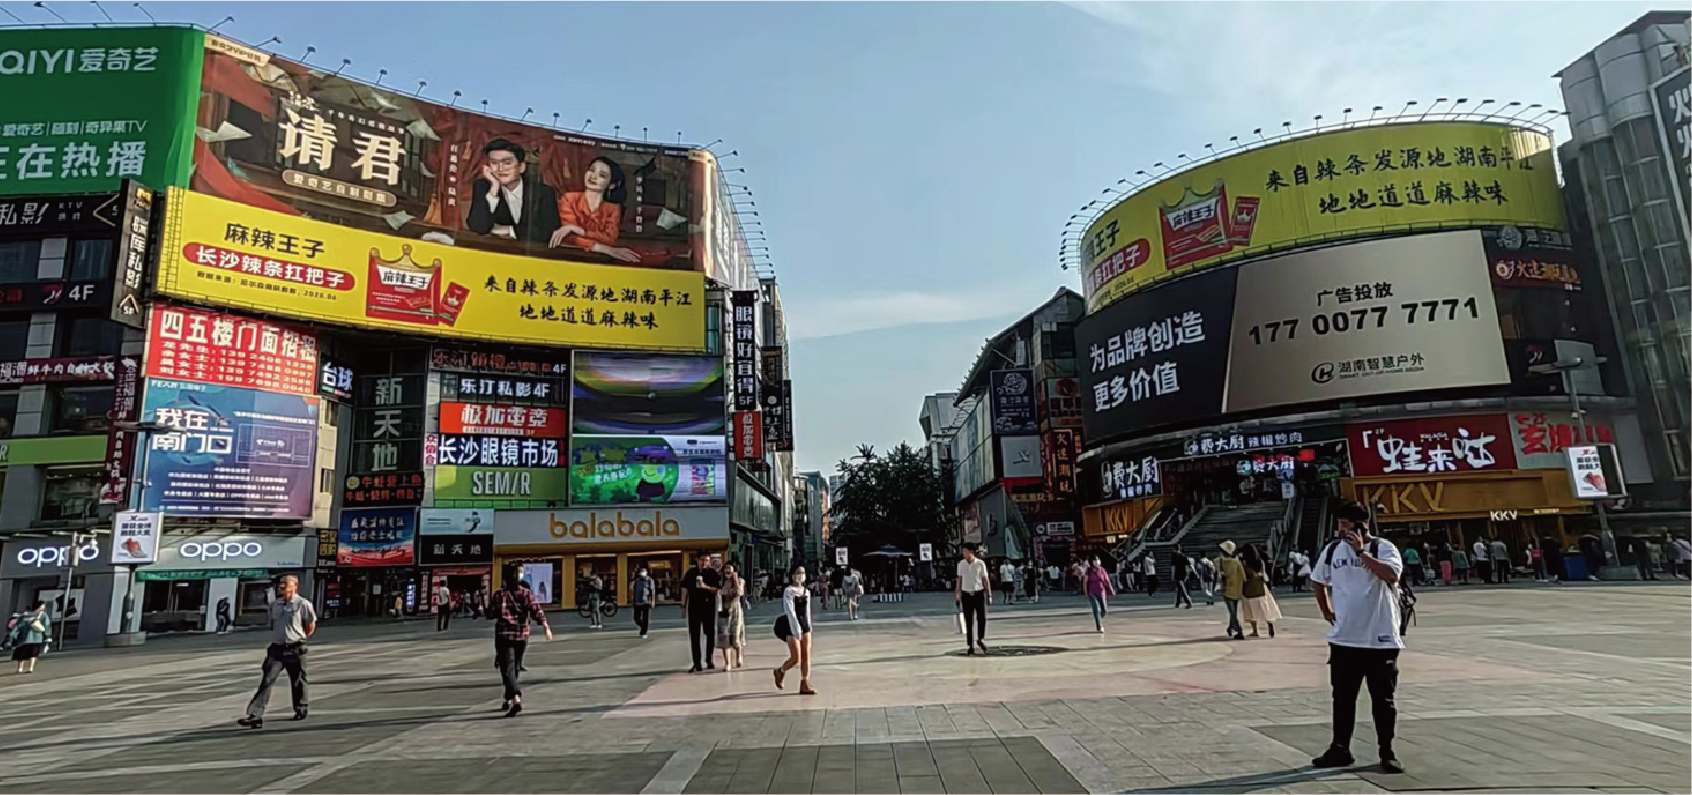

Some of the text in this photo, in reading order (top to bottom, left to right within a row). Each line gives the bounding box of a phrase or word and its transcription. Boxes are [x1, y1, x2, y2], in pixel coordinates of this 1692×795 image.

[78, 47, 160, 72] 爱奇艺
[0, 141, 147, 180] 在热播
[278, 107, 406, 186] 请君
[1319, 180, 1509, 215] 地地道道麻辣味
[224, 222, 325, 259] 麻辣王子
[196, 244, 345, 288] 长沙辣条扛把子
[68, 284, 95, 302] 4F
[484, 275, 692, 306] 来自辣条发源地湖南平江
[1317, 281, 1393, 306] 广告投放
[520, 303, 659, 330] 地地道道麻辣味
[1249, 297, 1480, 345] 177 0077 7771
[1089, 311, 1206, 374] 为品牌创造
[323, 362, 354, 391] 台球
[553, 363, 568, 374] 4F
[1338, 351, 1424, 374] 湖南智慧户外
[739, 395, 754, 405] 5F
[1093, 360, 1180, 413] 更多价值
[156, 408, 210, 431] 我在
[371, 378, 404, 473] 新天地
[439, 434, 559, 468] 长沙眼镜市场
[1112, 455, 1159, 489] 费大厨
[1363, 482, 1444, 514] KKV
[549, 511, 681, 538] balabala
[1490, 509, 1518, 521] KKV
[180, 542, 262, 561] oppo
